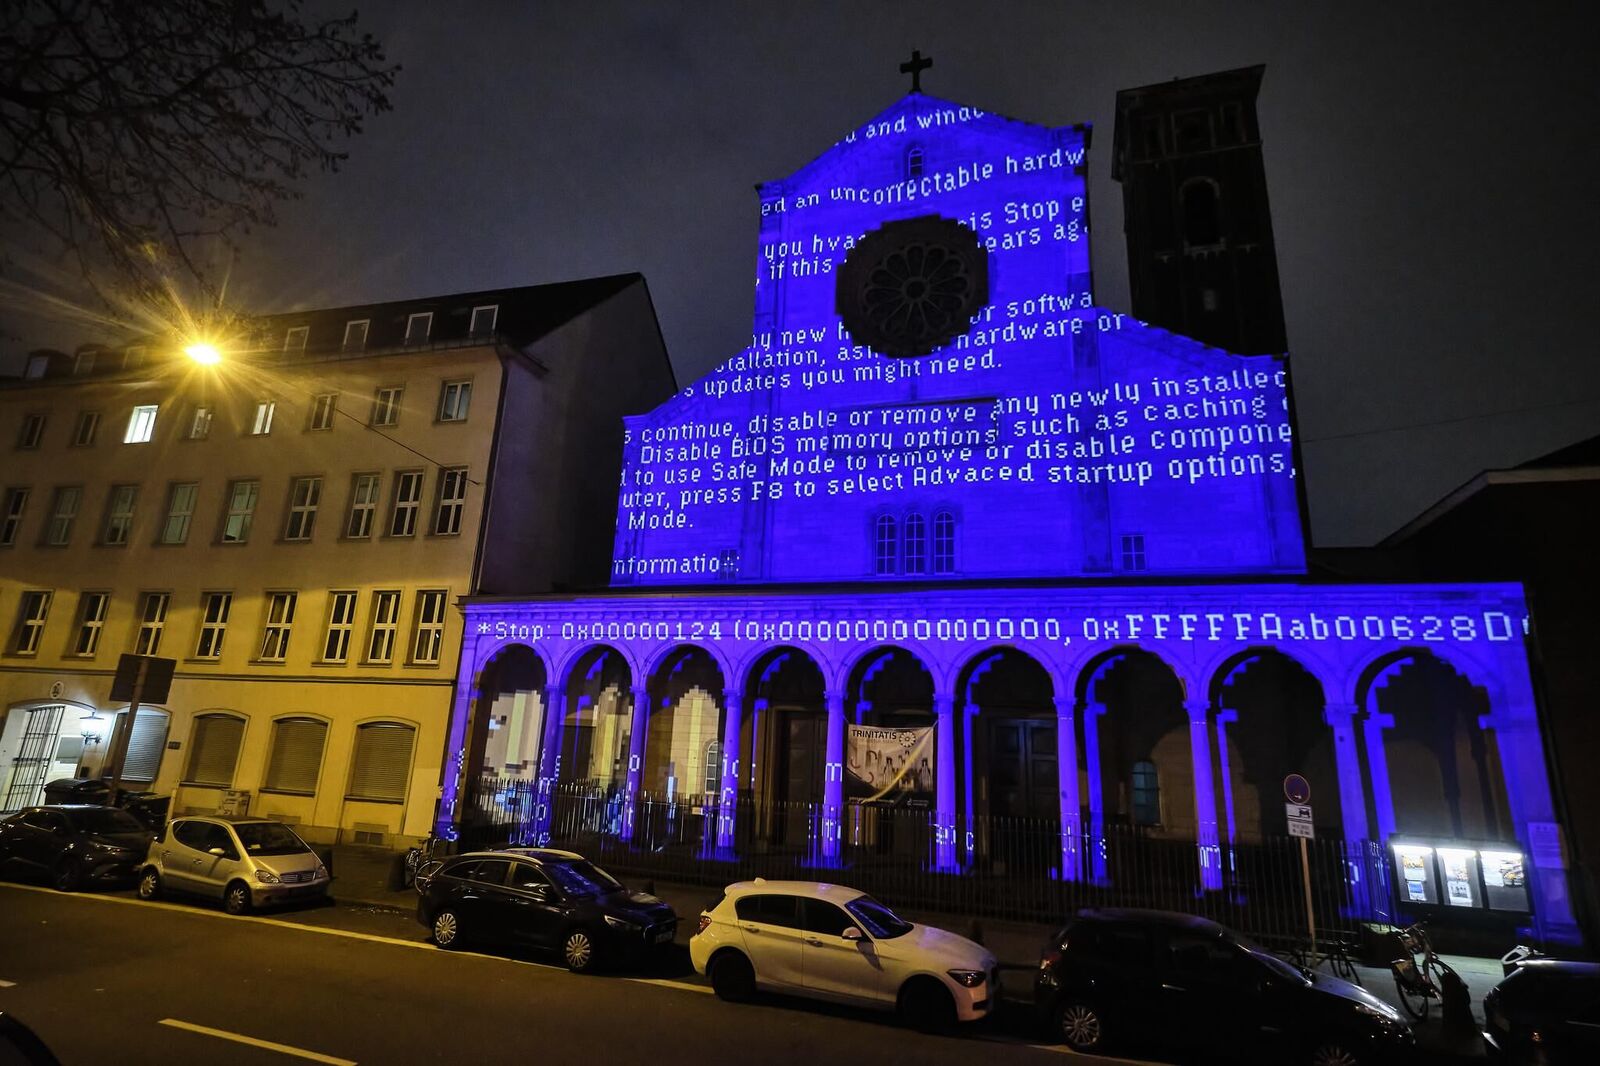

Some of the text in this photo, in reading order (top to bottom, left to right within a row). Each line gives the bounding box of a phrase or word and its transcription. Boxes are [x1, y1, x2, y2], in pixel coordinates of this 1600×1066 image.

[865, 115, 907, 139] and
[761, 148, 1085, 216] ed an uncorrectable hardw
[764, 240, 803, 265] you
[1004, 200, 1059, 224] Stop
[770, 260, 785, 280] if
[791, 256, 832, 277] this
[780, 327, 826, 346] new
[1006, 292, 1092, 318] softwa
[1098, 313, 1125, 332] or
[704, 373, 791, 399] updates
[802, 368, 845, 390] you
[853, 358, 921, 384] might
[929, 346, 1002, 375] need.
[640, 394, 1267, 464] Disable BIOS memory options such as caching
[641, 421, 740, 442] continue,
[748, 409, 838, 434] disable
[849, 410, 873, 426] or
[880, 406, 976, 425] remove
[990, 395, 1039, 417] any
[1050, 382, 1140, 410] newly
[622, 451, 1296, 511] uter, press F8 to select Advaced startup options,
[635, 469, 654, 486] to
[664, 467, 701, 485] use
[711, 460, 757, 482] Safe
[769, 454, 835, 477] Mode
[846, 455, 867, 471] to
[876, 447, 972, 469] remove
[986, 444, 1014, 460] or
[1026, 433, 1135, 459] disable
[1151, 423, 1292, 452] compone
[628, 509, 693, 530] Mode.
[561, 621, 722, 641] 0x00000124
[852, 729, 897, 740] TRINITATIS
